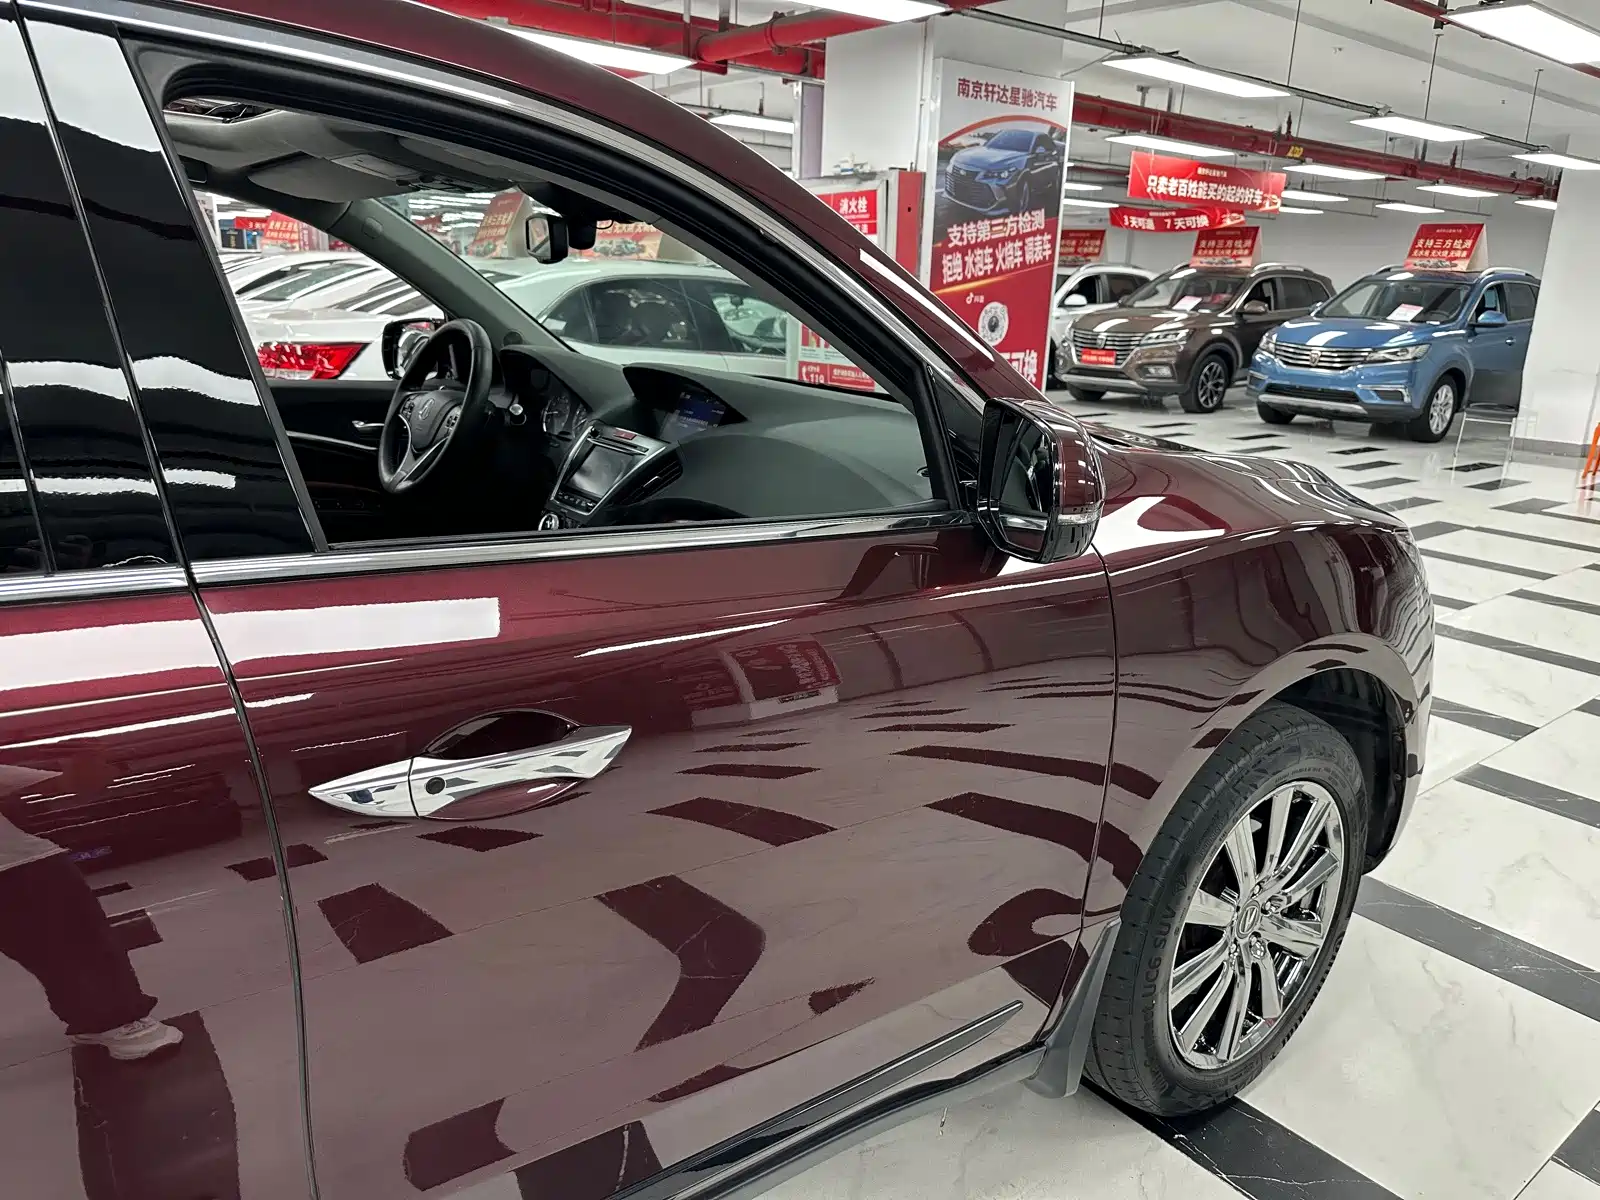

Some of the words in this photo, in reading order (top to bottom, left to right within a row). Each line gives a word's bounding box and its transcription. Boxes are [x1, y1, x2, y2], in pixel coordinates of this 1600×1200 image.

[957, 77, 1058, 112] 南京轩达星驰汽车
[839, 195, 868, 214] 消火栓
[1146, 175, 1264, 206] 只卖老百姓能买的起的好车
[947, 208, 1045, 249] 支持第三方检测
[1415, 238, 1474, 250] 支持三方检测
[942, 251, 963, 285] 拒绝
[964, 246, 994, 280] 水泡车
[995, 239, 1024, 273] 火烧车
[1024, 232, 1053, 265] 调表车
[1000, 349, 1038, 384] 可换
[1142, 956, 1162, 999] UC6
[1153, 904, 1177, 951] SUV
